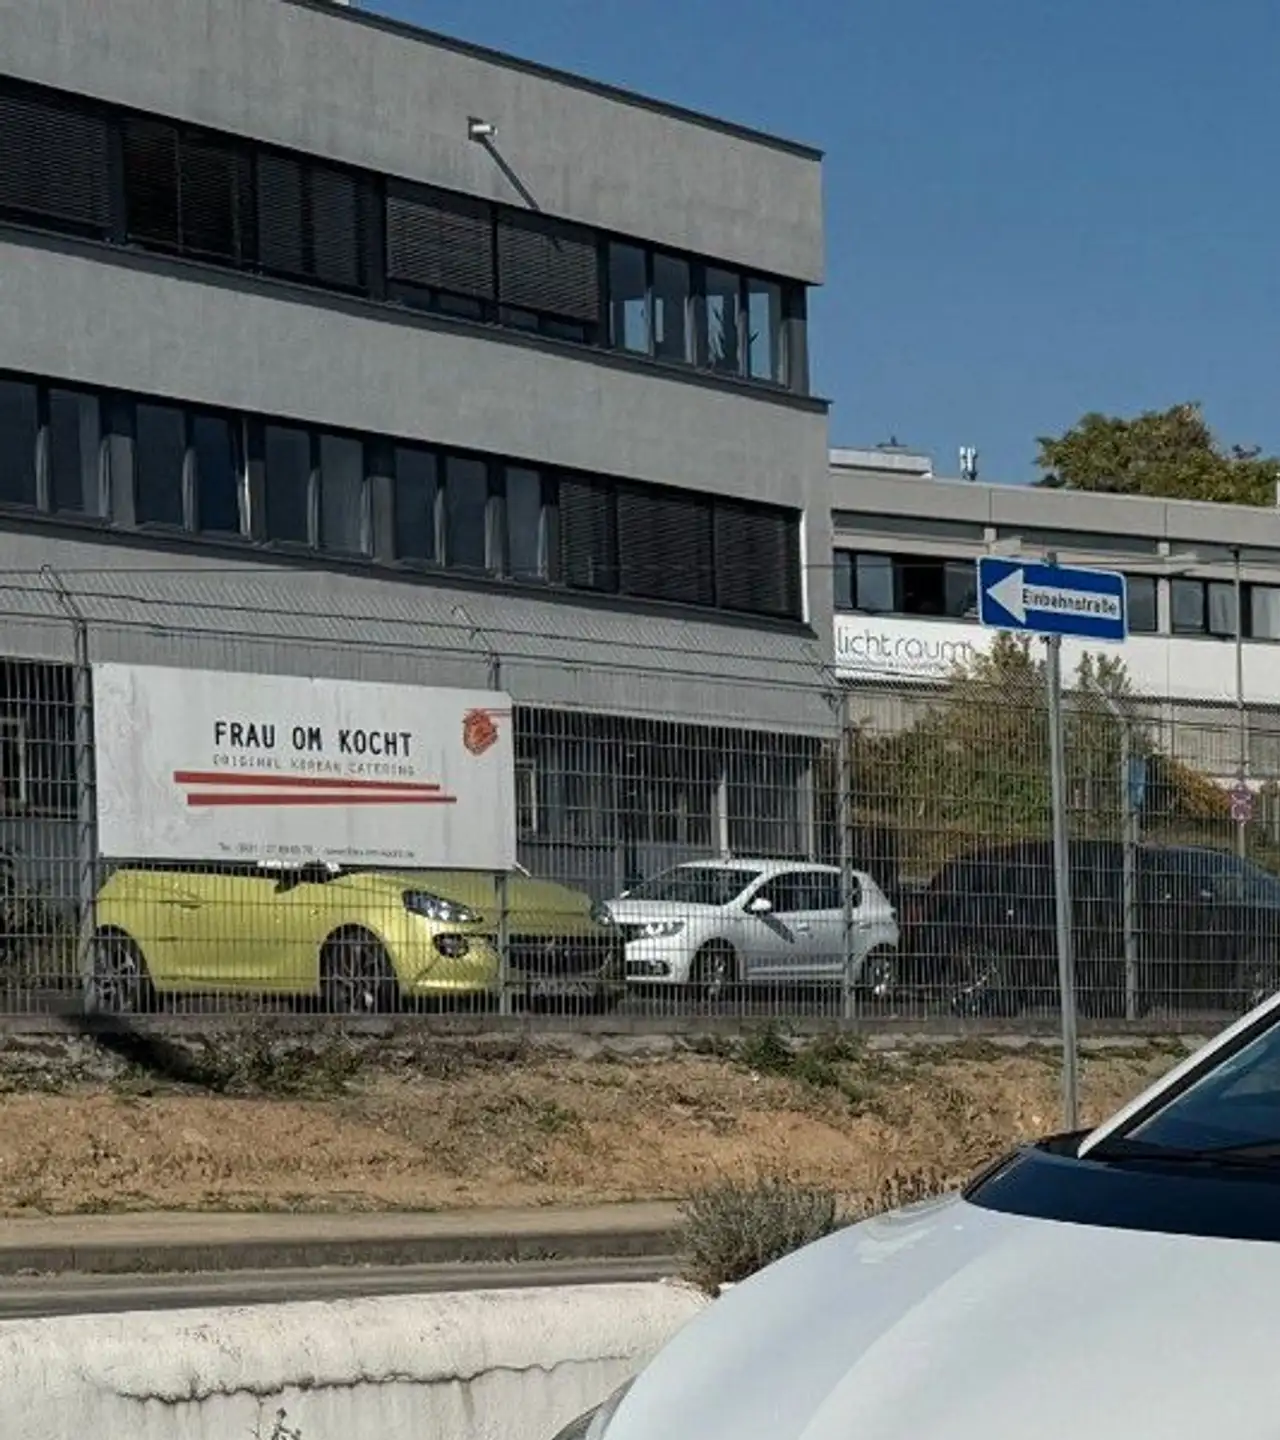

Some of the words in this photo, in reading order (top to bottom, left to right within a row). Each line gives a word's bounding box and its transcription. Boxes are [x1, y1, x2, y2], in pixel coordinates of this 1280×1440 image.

[1022, 588, 1118, 615] Einbahnstraße
[214, 720, 276, 749] FRAU
[292, 726, 323, 751] OM
[338, 729, 412, 757] KOCHT
[213, 753, 281, 769] ORIGINAL
[290, 758, 342, 774] KOREAN
[348, 761, 415, 777] CATERING
